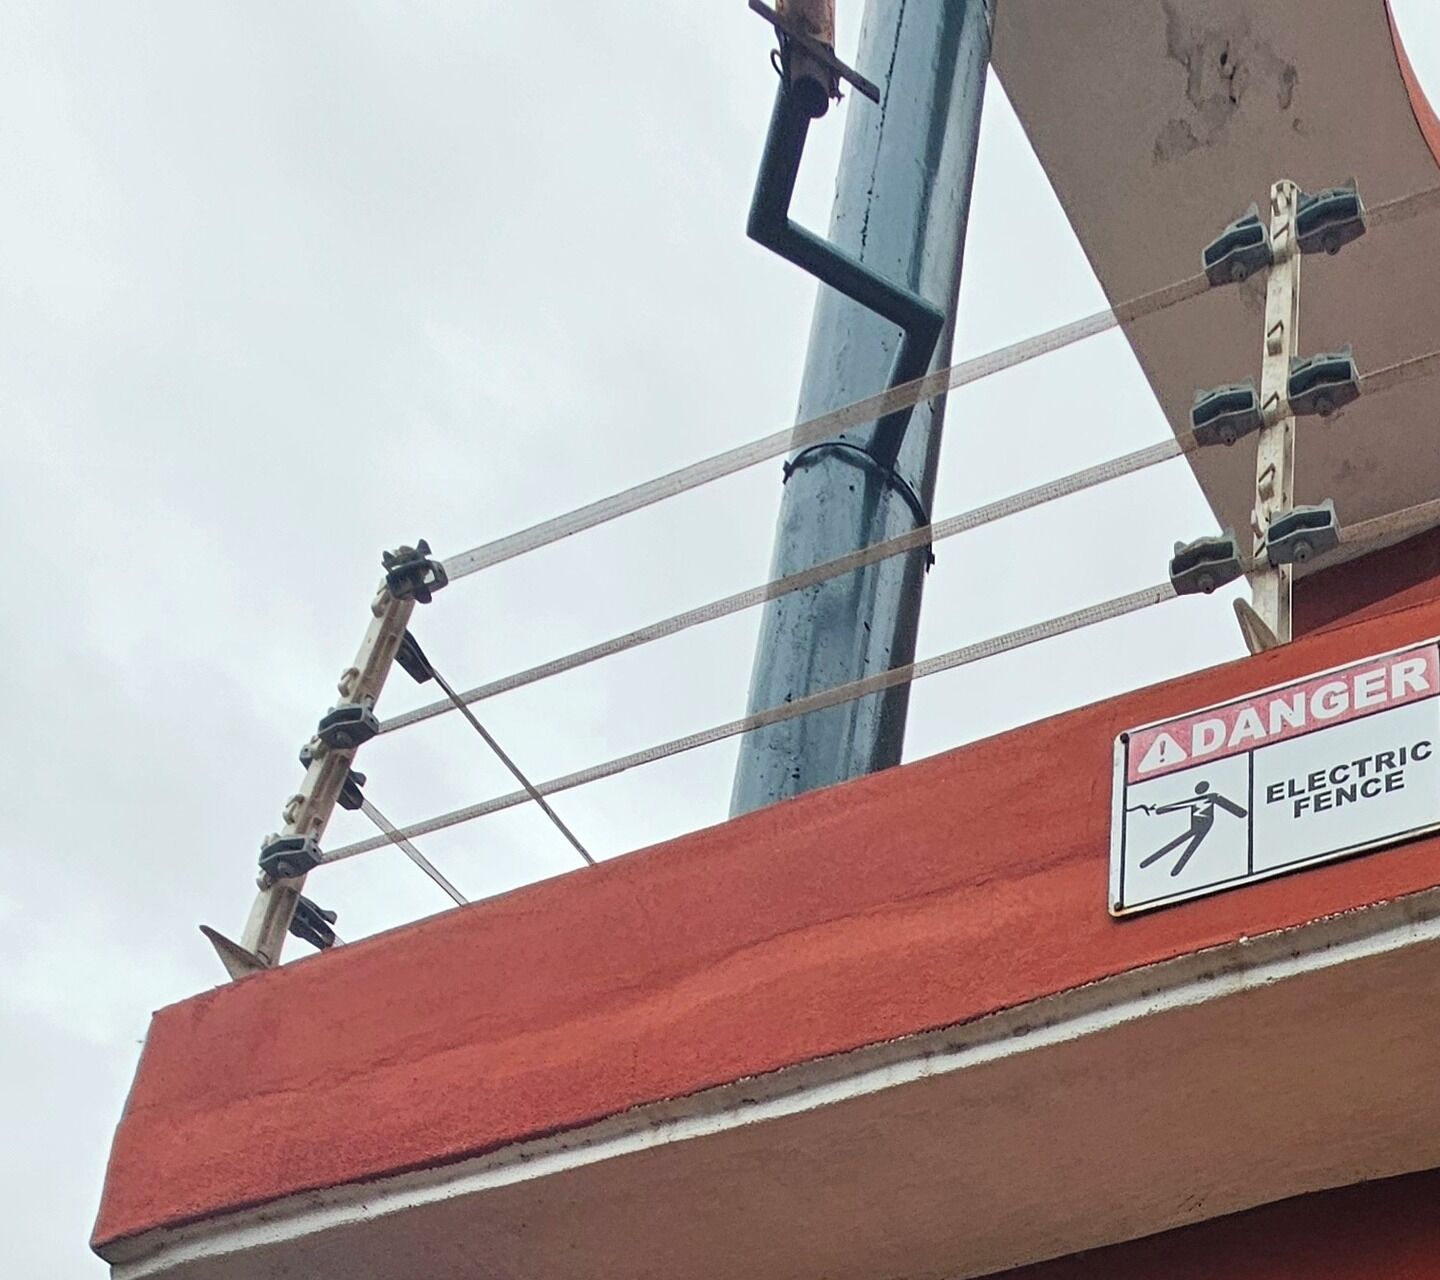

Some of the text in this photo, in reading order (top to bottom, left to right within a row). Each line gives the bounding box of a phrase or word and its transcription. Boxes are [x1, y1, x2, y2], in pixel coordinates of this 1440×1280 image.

[1190, 657, 1430, 758] DANGER
[1266, 740, 1432, 804] ELECTRIC
[1293, 769, 1405, 818] FENCE
